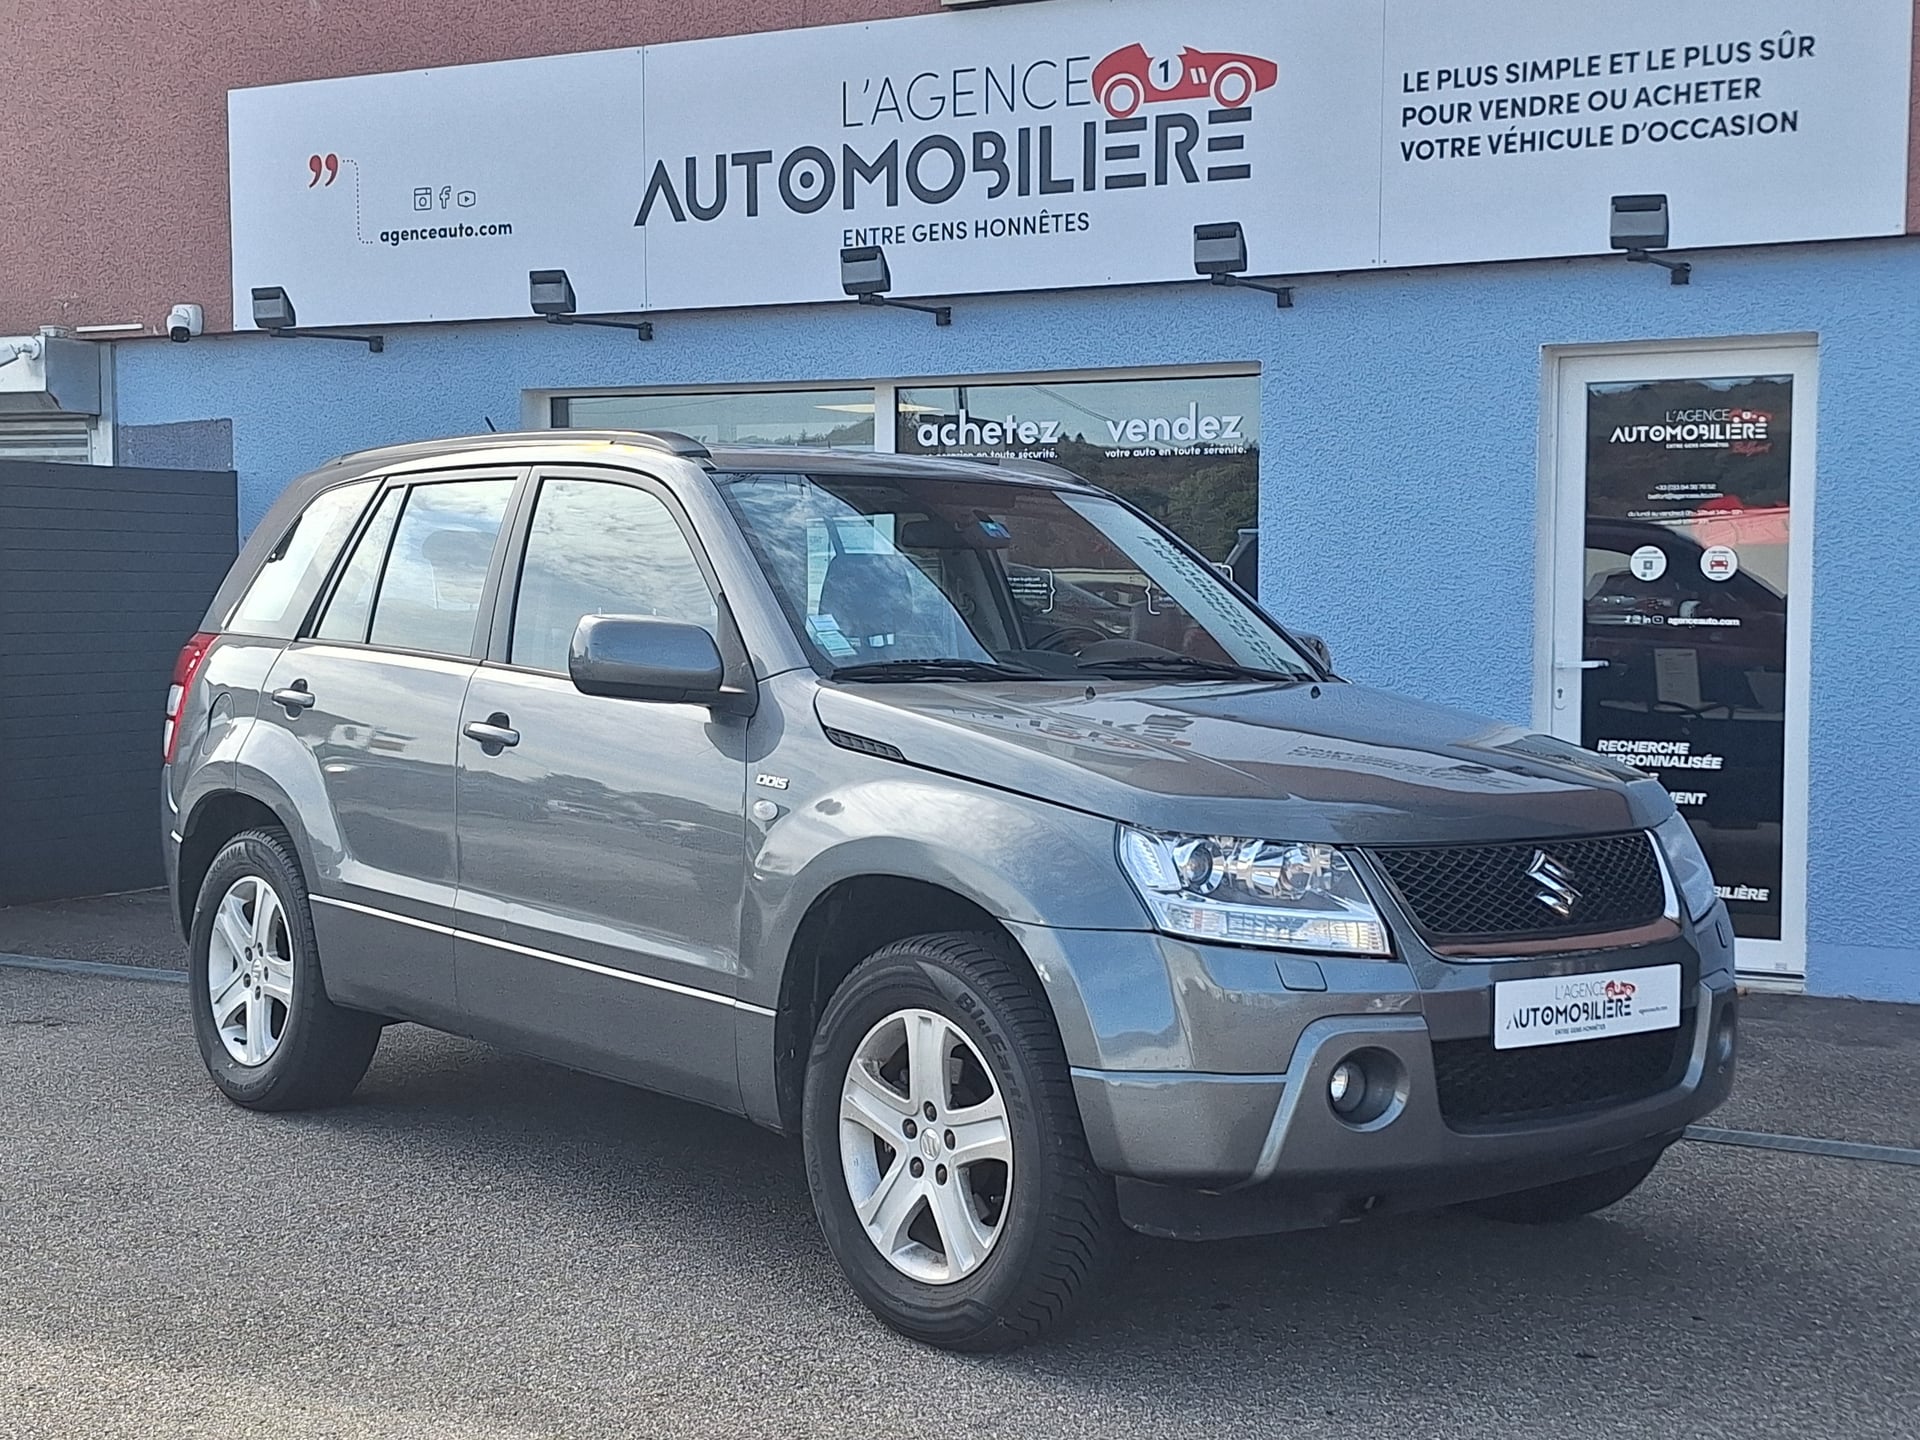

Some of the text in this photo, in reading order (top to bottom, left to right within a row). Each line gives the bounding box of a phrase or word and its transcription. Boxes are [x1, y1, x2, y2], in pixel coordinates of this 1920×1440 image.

[1403, 30, 1816, 93] LE PLUS SIMPLE ET LE PLUS SÛR
[842, 56, 1092, 128] L'AGENCE
[1402, 77, 1761, 128] POUR VENDRE OU ACHETER
[1401, 110, 1799, 162] VOTRE VÉHICULE D'OCCASION
[379, 221, 513, 246] agenceauto.com
[843, 209, 1090, 248] ENTRE GENS HONNÊTES
[917, 409, 1060, 446] achetez
[1104, 401, 1243, 443] vendez
[1665, 408, 1730, 423] L'AGENCE
[1105, 448, 1130, 458] votre
[1133, 447, 1156, 457] auto
[1159, 449, 1171, 457] en
[1174, 447, 1201, 456] toute
[1597, 739, 1690, 754] RECHERCHE
[1601, 753, 1724, 769] RSONNALISÉE
